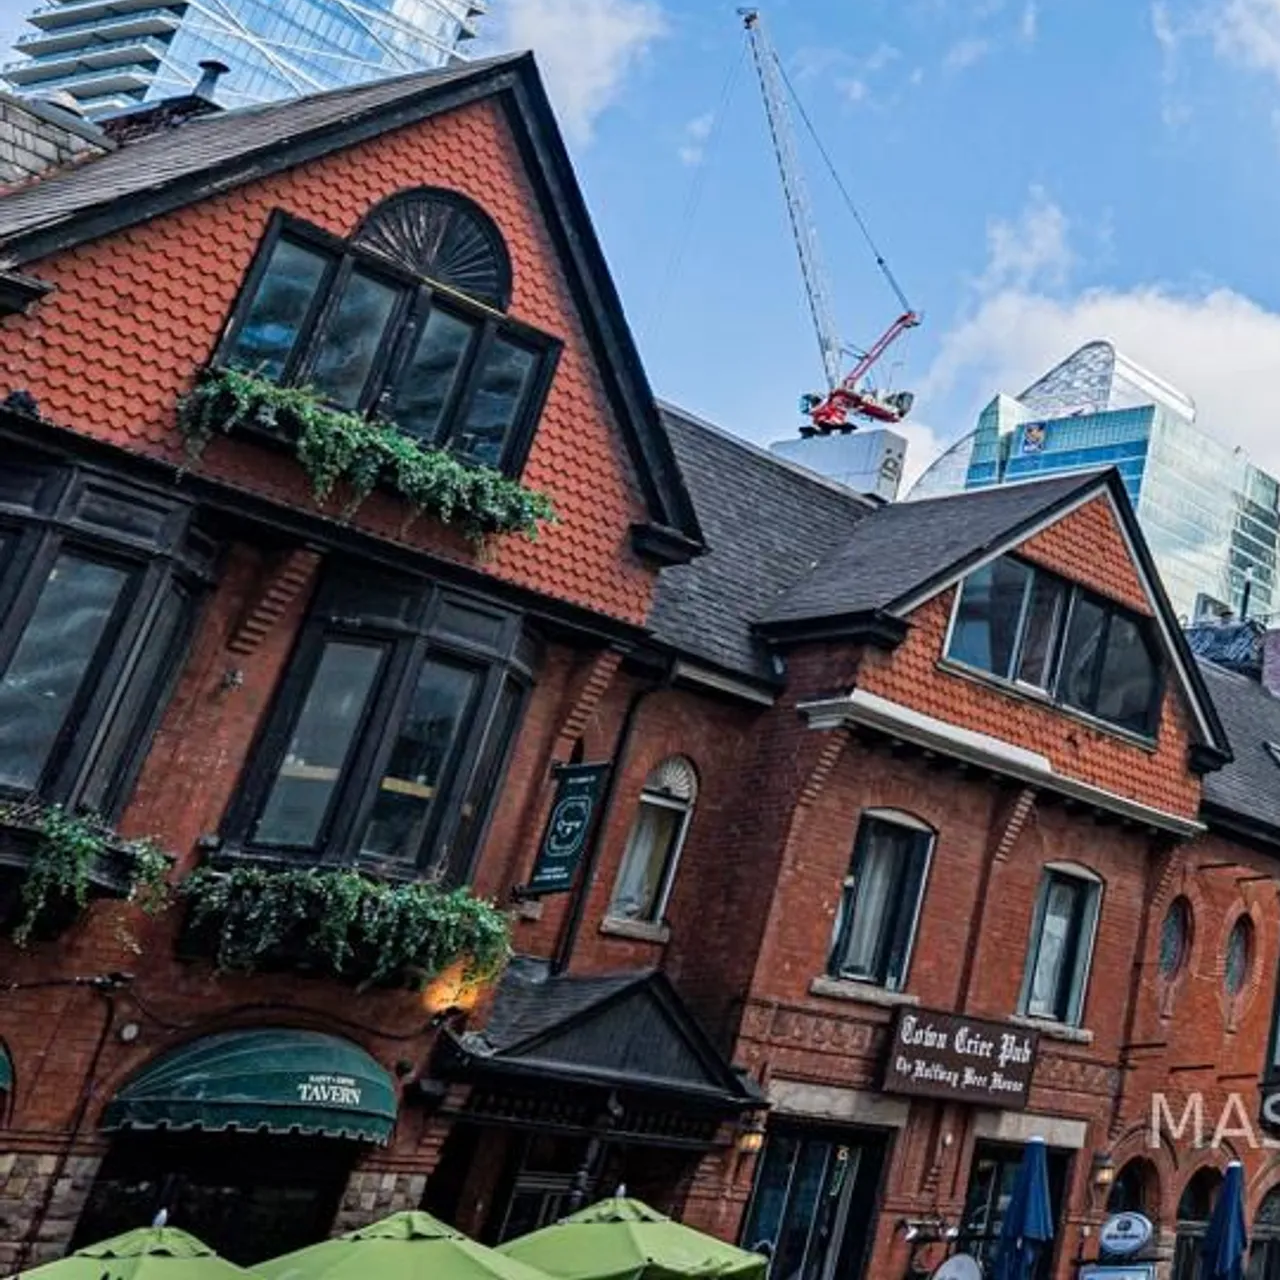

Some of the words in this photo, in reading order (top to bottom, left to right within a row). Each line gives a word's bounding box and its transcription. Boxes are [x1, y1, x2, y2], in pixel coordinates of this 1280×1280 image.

[901, 1015, 947, 1049] Town
[955, 1026, 994, 1057] Crier
[998, 1033, 1032, 1067] Pub
[297, 1083, 361, 1105] TAVERN
